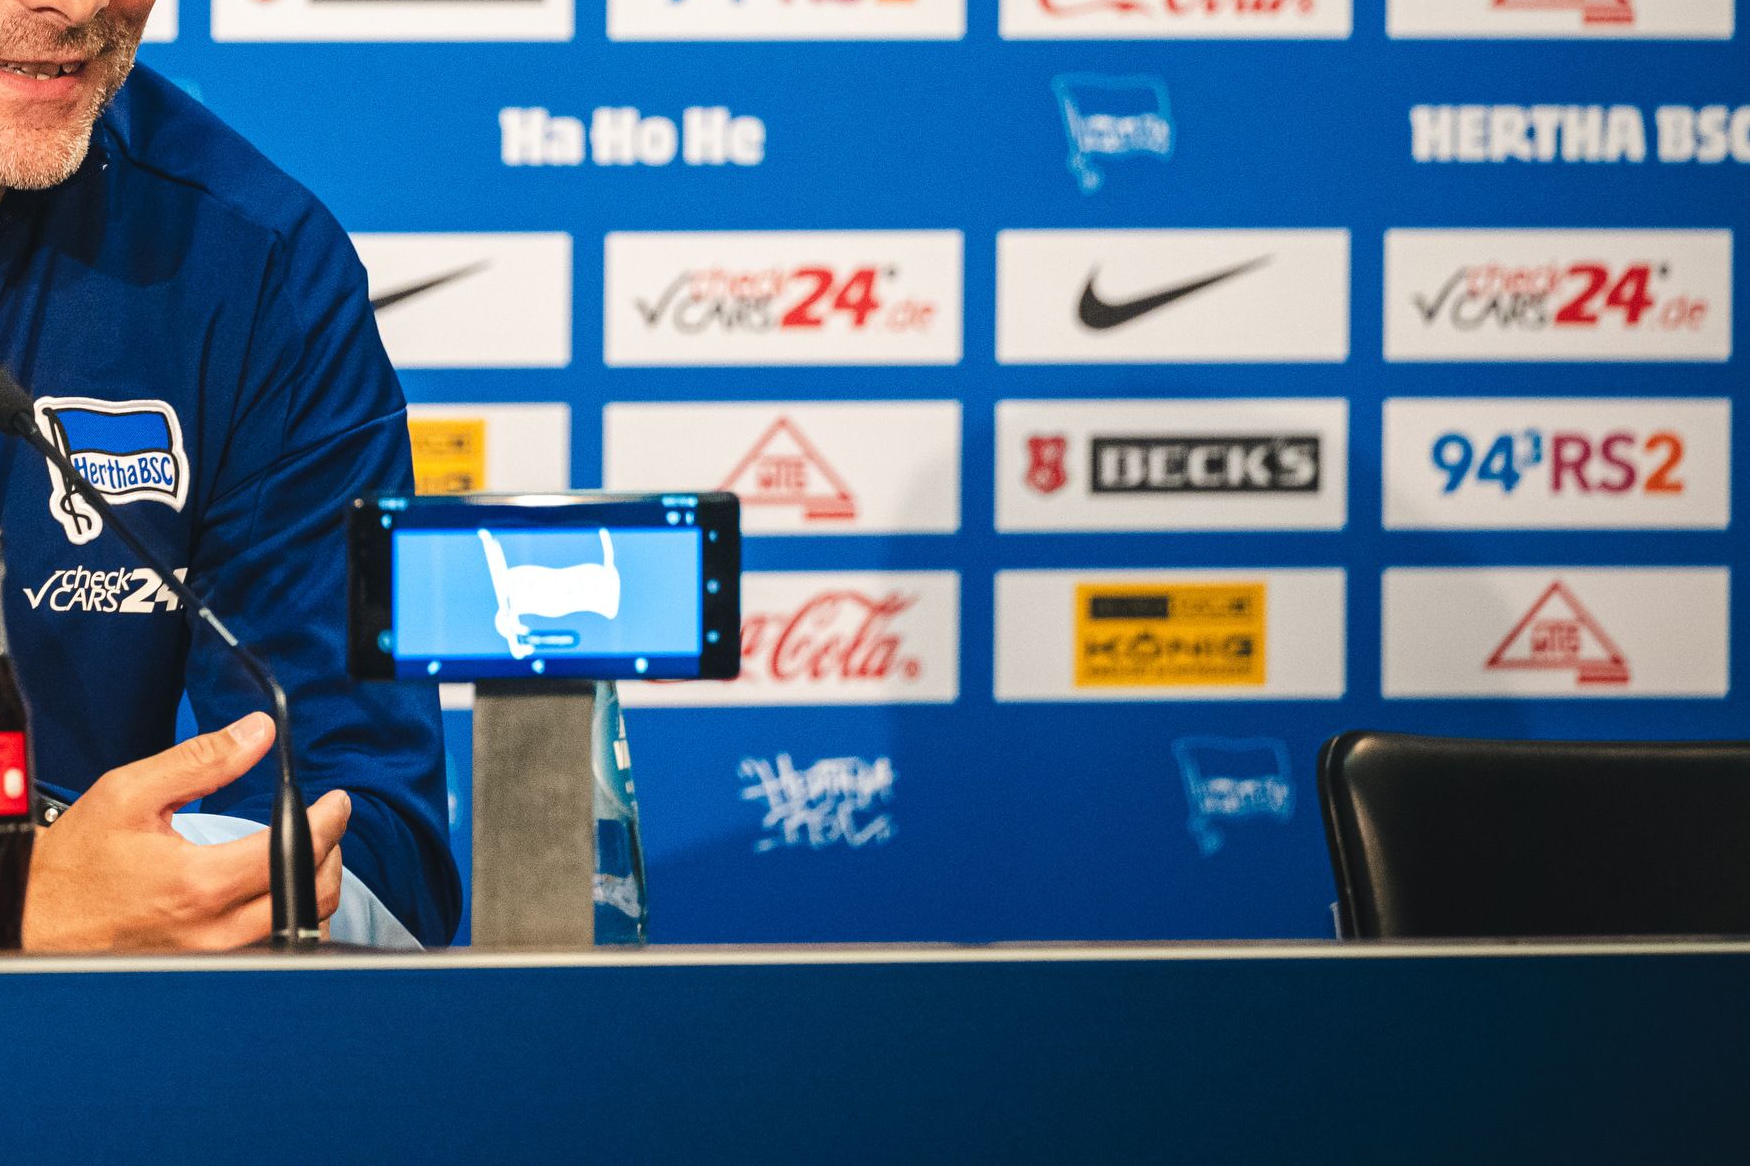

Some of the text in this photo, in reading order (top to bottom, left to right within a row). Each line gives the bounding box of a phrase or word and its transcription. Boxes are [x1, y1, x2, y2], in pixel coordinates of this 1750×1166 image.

[498, 106, 766, 166] Ha Ho He
[1409, 104, 1647, 163] HERTHA
[780, 267, 880, 328] 24
[1555, 265, 1653, 325] 24
[49, 587, 122, 614] CARS
[61, 564, 134, 591] check
